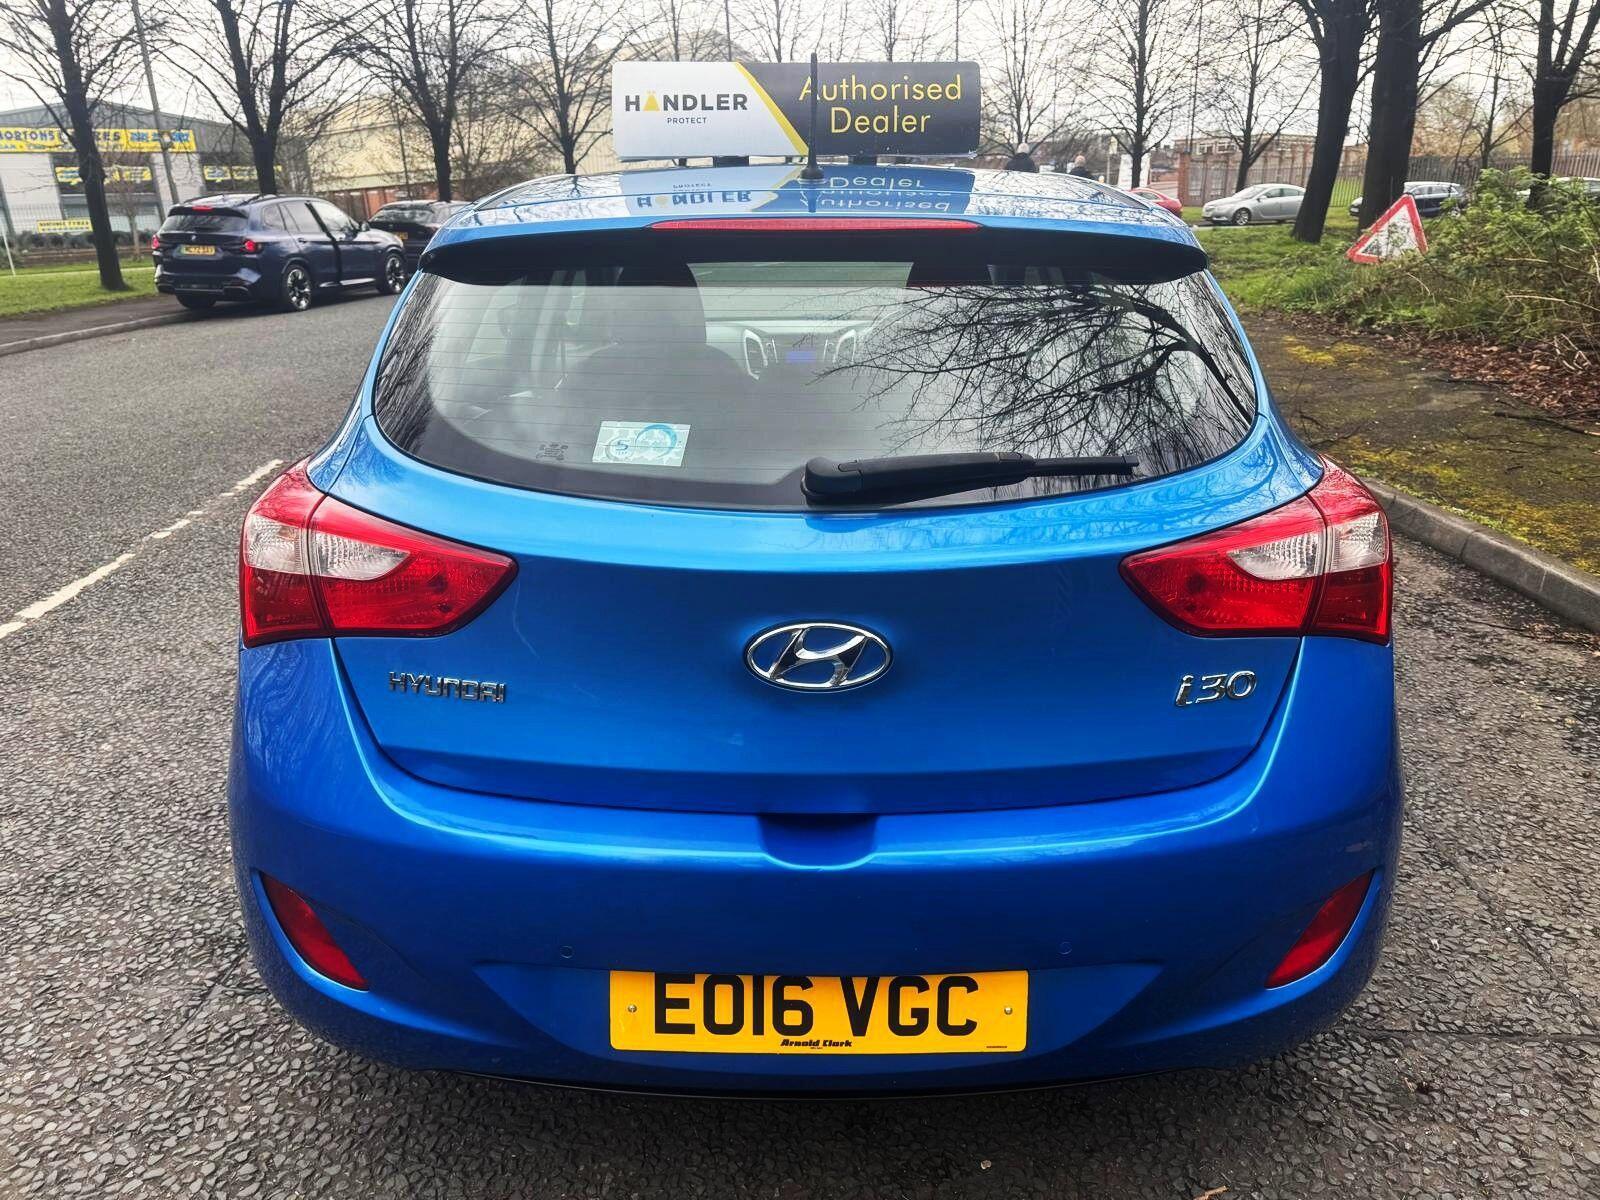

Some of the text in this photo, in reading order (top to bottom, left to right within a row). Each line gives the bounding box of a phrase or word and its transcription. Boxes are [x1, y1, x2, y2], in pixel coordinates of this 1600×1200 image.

[800, 75, 962, 100] Authorised
[830, 107, 931, 133] Dealer
[389, 671, 505, 703] HYUNDAI
[1175, 670, 1257, 706] i30
[655, 973, 979, 1036] EO16 VGC
[781, 1039, 820, 1047] Arnold
